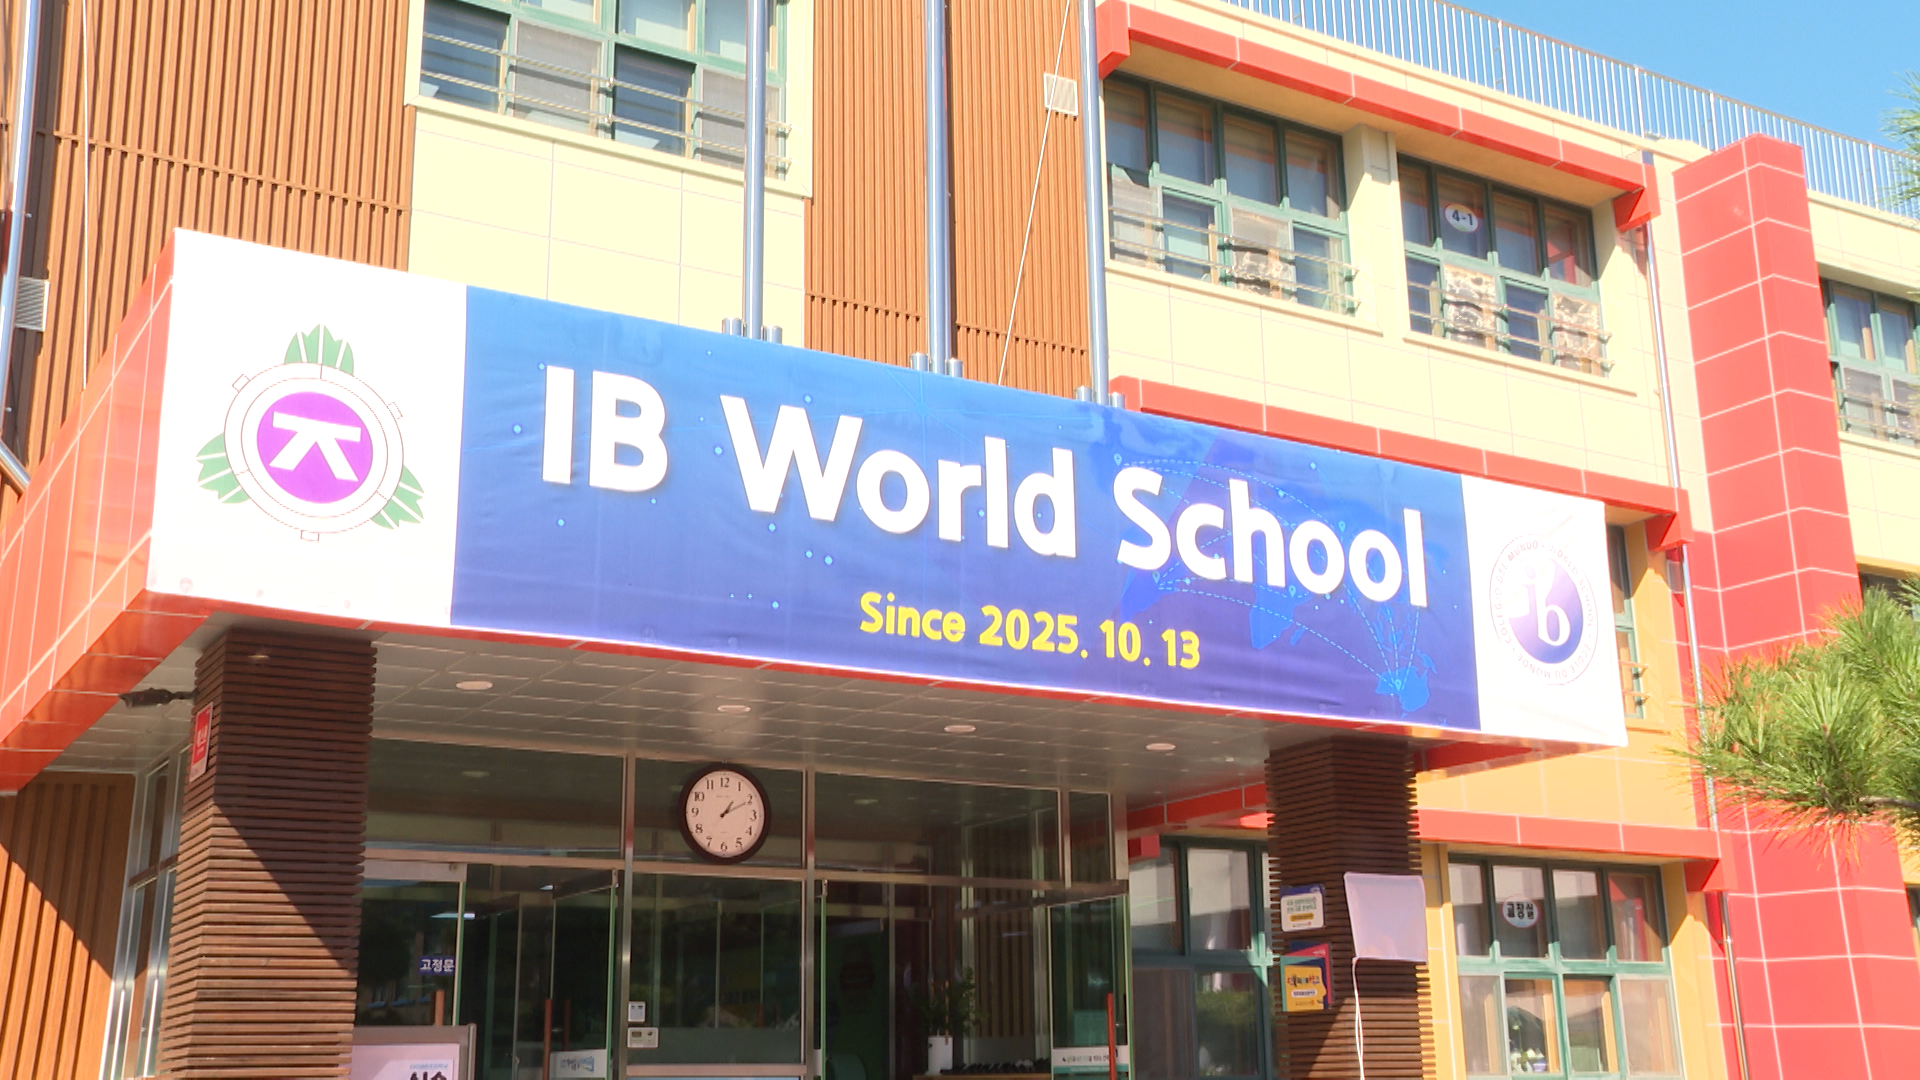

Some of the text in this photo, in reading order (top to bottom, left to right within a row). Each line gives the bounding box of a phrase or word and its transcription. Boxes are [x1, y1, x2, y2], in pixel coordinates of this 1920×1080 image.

[1451, 209, 1473, 226] 4-1
[542, 365, 1428, 608] IB World School
[1507, 539, 1539, 562] MUNDO
[859, 591, 1200, 669] Since 2025. 10. 13
[705, 779, 714, 789] 11
[720, 777, 730, 788] 12
[737, 781, 741, 791] 1
[694, 791, 705, 802] 10
[746, 793, 753, 805] 2
[691, 807, 699, 818] 9
[749, 809, 757, 821] 3
[695, 823, 703, 834] 8
[745, 825, 753, 836] 4
[705, 835, 712, 848] 7
[720, 841, 728, 852] 6
[735, 837, 743, 848] 5
[420, 958, 455, 972] 고정문
